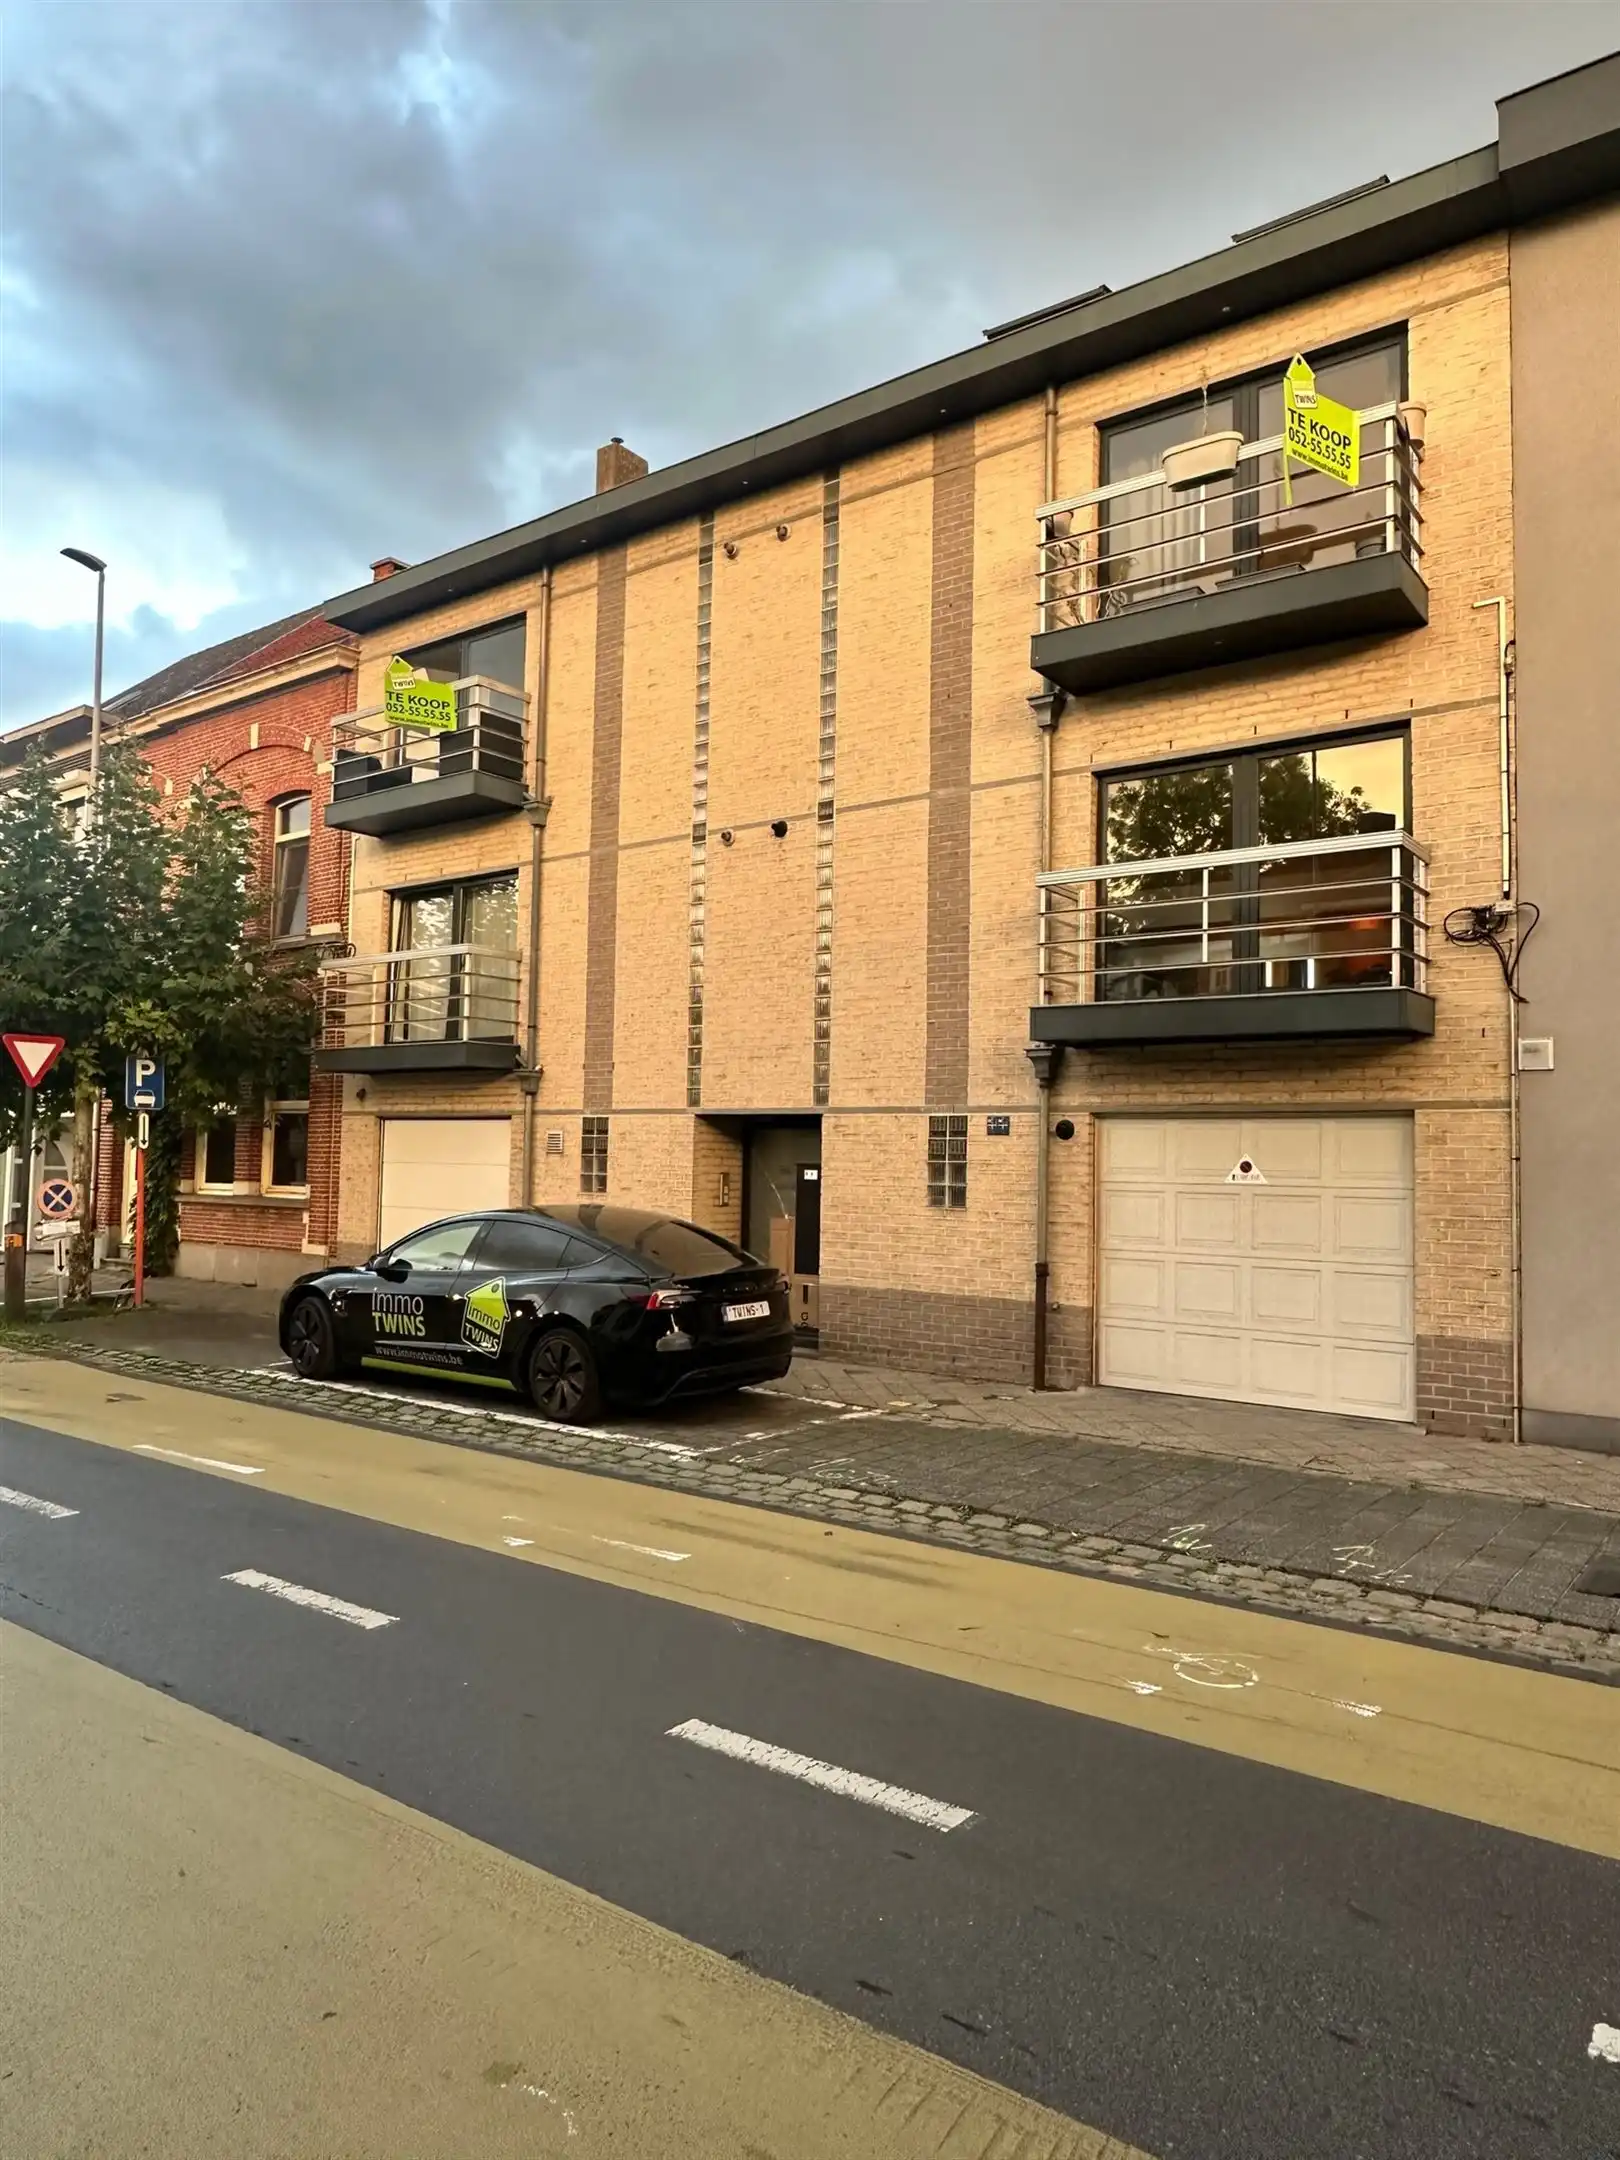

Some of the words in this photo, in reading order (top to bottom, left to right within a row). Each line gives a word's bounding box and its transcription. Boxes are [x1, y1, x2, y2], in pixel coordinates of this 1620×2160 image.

[1295, 394, 1316, 404] TWINS
[1287, 408, 1306, 431] TE
[1310, 419, 1352, 450] KOOP
[1288, 428, 1352, 470] 052-55.55.55
[385, 691, 404, 703] TE
[408, 695, 450, 710] KOOP
[386, 703, 451, 721] 052-55.55.55
[135, 1059, 156, 1087] P
[372, 1287, 424, 1315] immo
[372, 1312, 426, 1337] TWINS
[468, 1305, 501, 1331] immo
[465, 1323, 500, 1350] TWINS
[375, 1346, 464, 1366] www.immotwins.be
